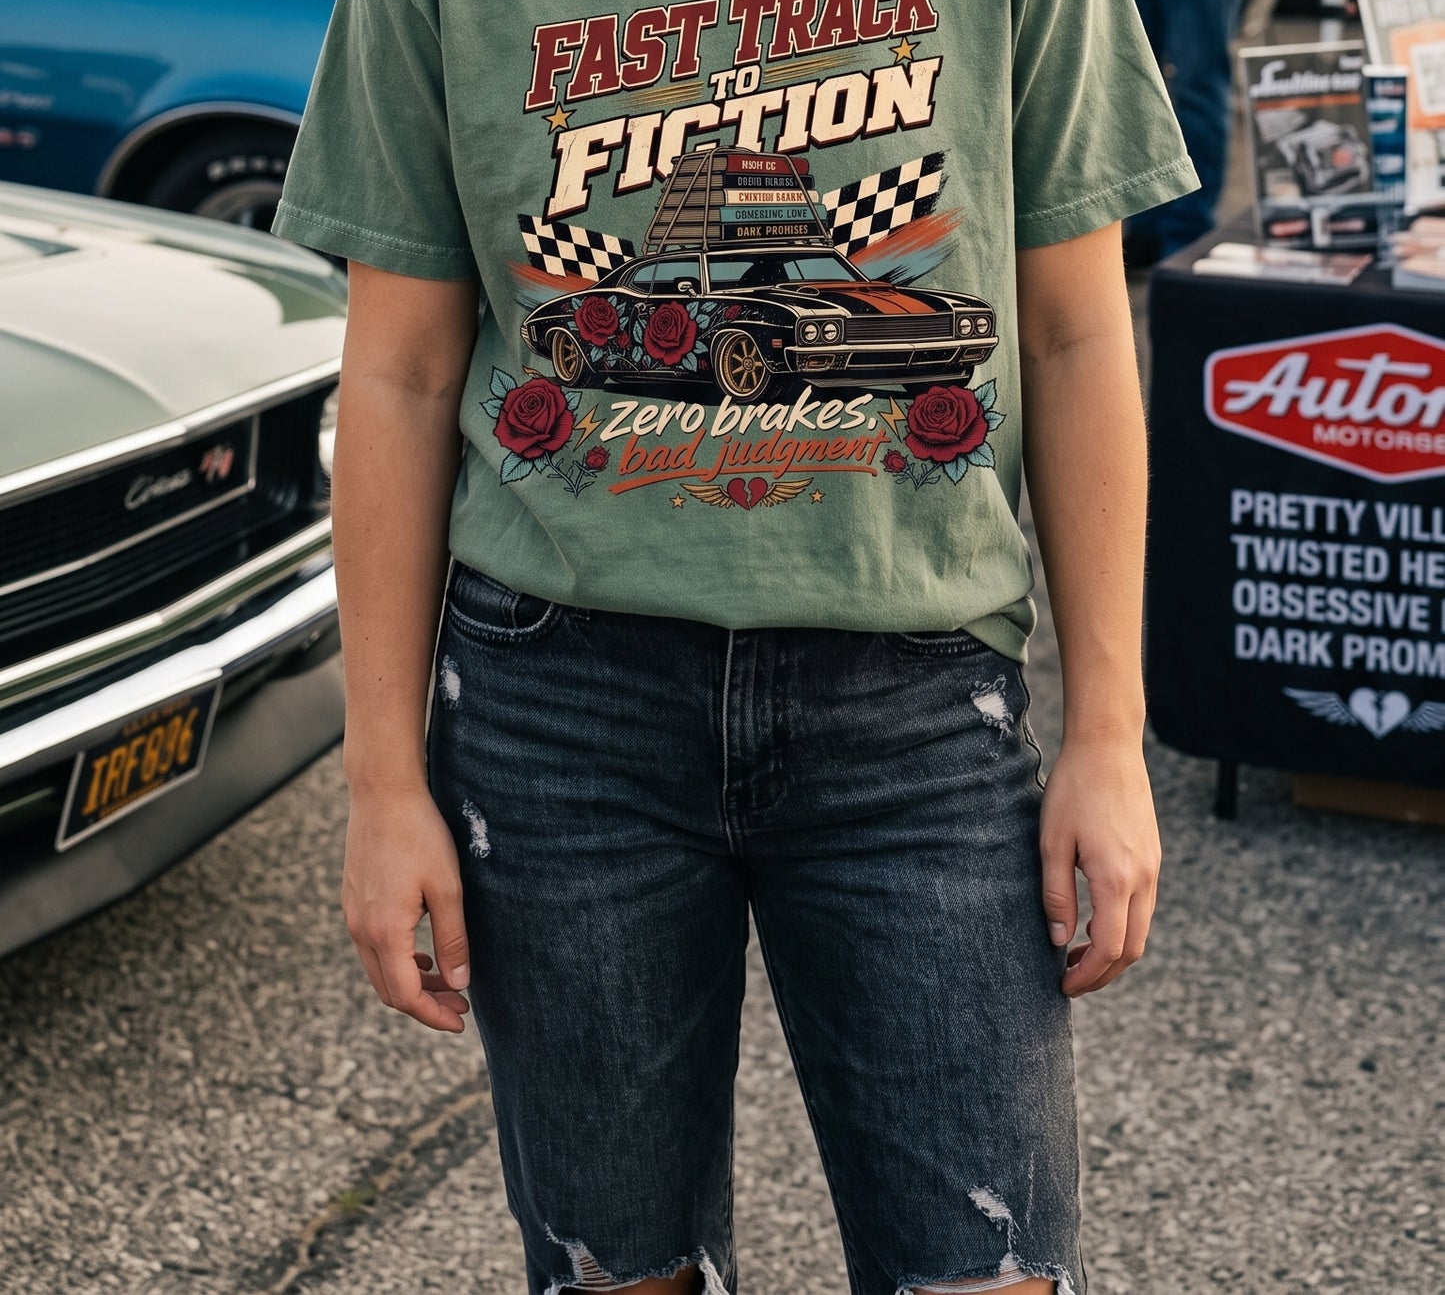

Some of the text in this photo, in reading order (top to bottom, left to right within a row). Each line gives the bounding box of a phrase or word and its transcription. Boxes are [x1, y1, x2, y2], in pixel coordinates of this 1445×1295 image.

[709, 64, 762, 102] TO
[546, 56, 942, 220] FICTION
[786, 209, 808, 219] LOVE
[600, 385, 877, 442] zero brakes.
[617, 427, 892, 481] bad judgment
[1230, 489, 1445, 544] PRETTY VILL
[1230, 534, 1445, 589] TWISTED HE
[1232, 579, 1431, 632] OBSESSIVE
[1234, 623, 1445, 679] DARK PROM
